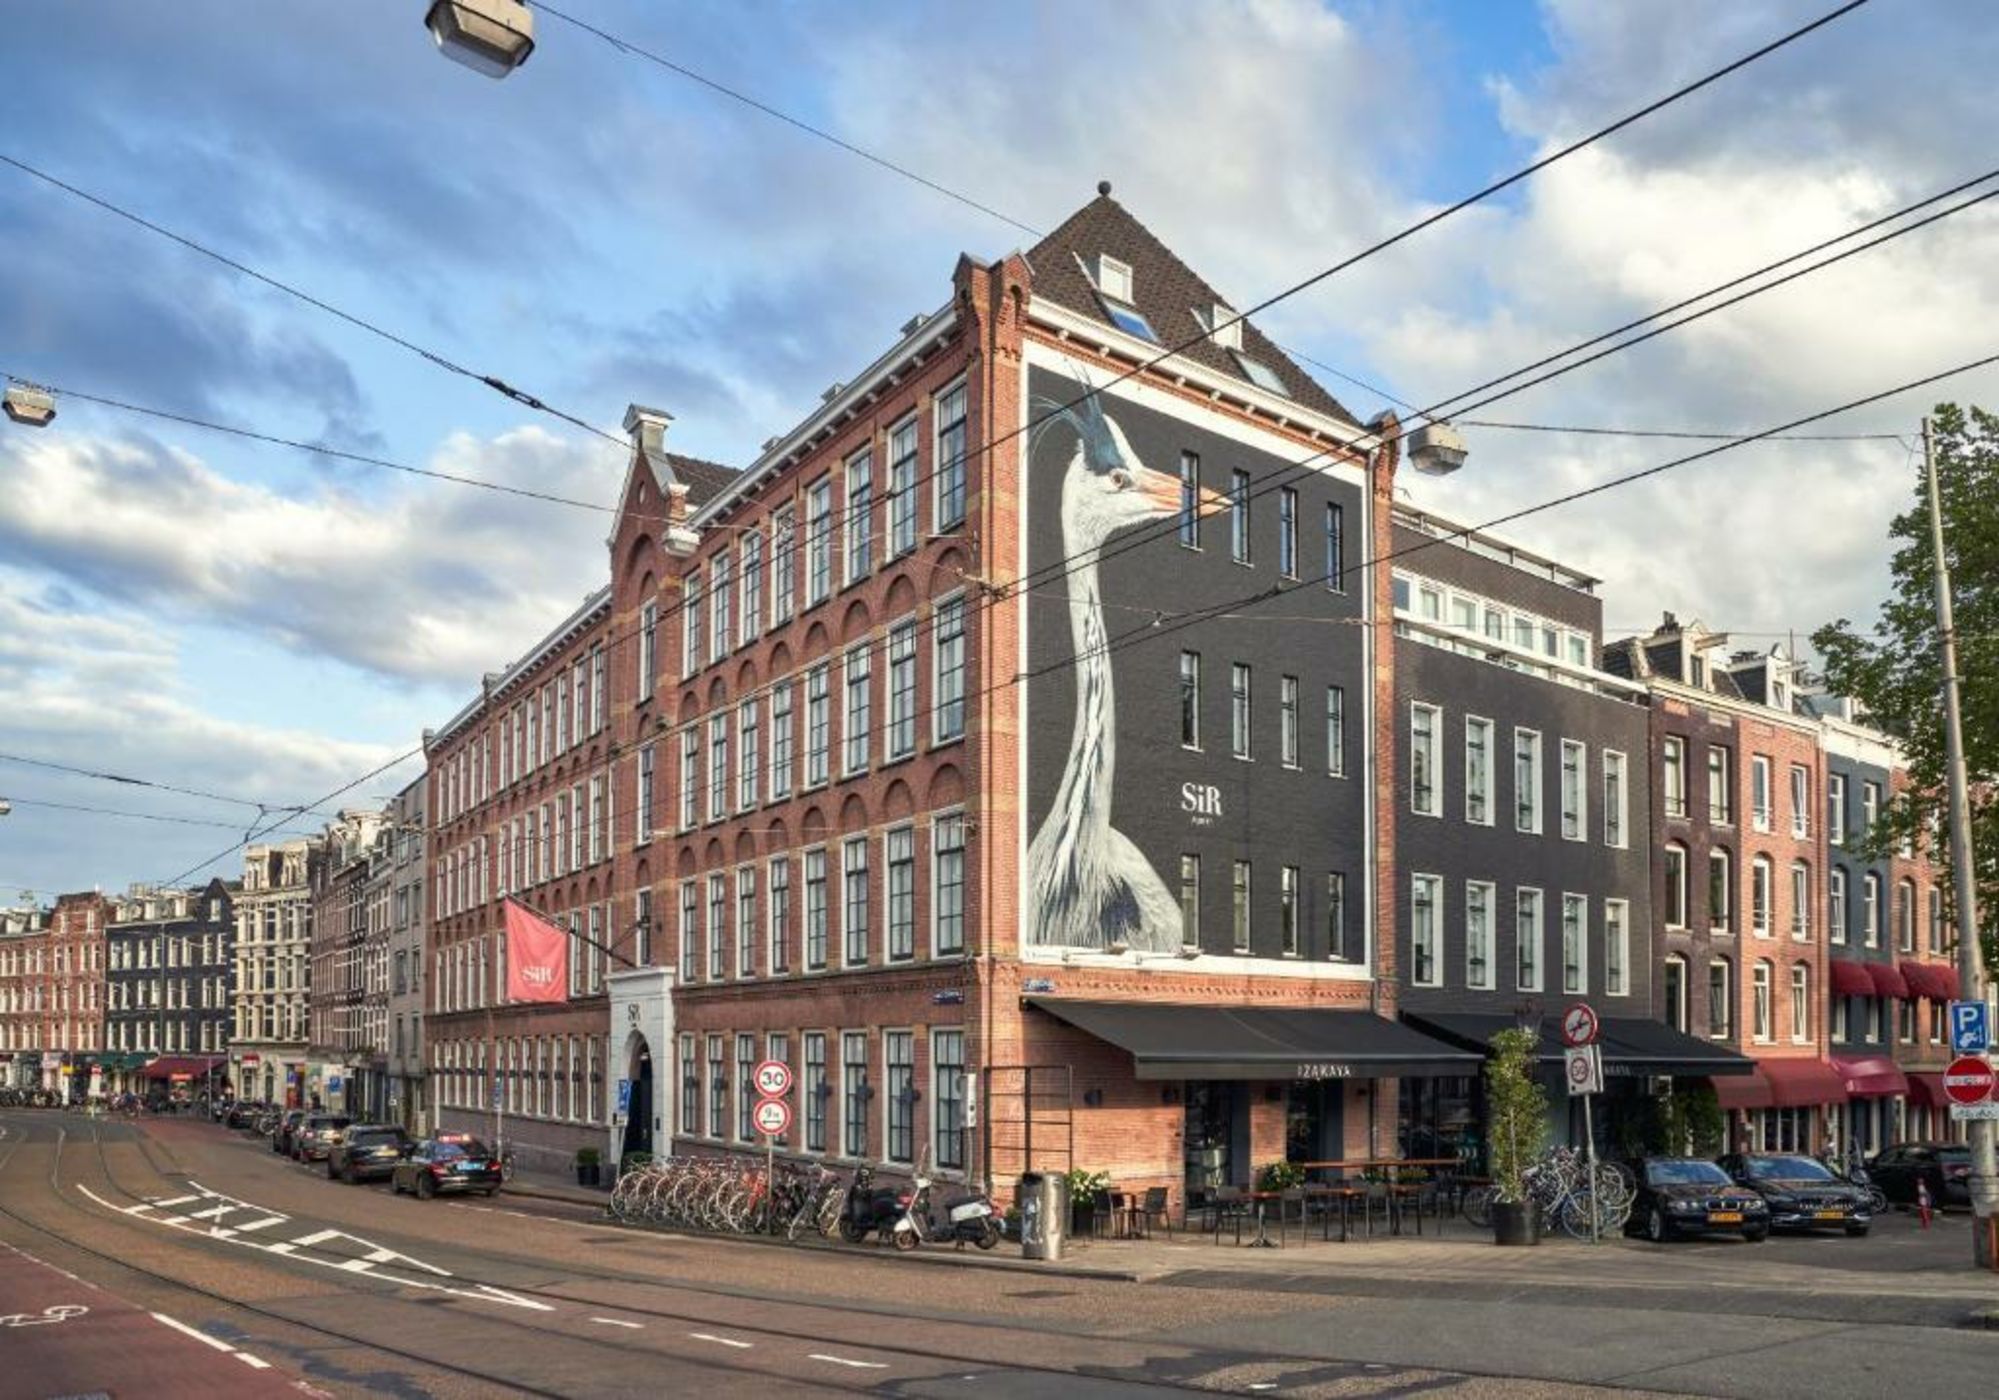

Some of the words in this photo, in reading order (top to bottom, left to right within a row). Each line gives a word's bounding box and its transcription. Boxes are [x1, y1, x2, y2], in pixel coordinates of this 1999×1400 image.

[1181, 782, 1222, 816] SiR
[1959, 1006, 1979, 1031] P
[762, 1072, 784, 1086] 30
[1297, 1064, 1352, 1080] IZAKAYA
